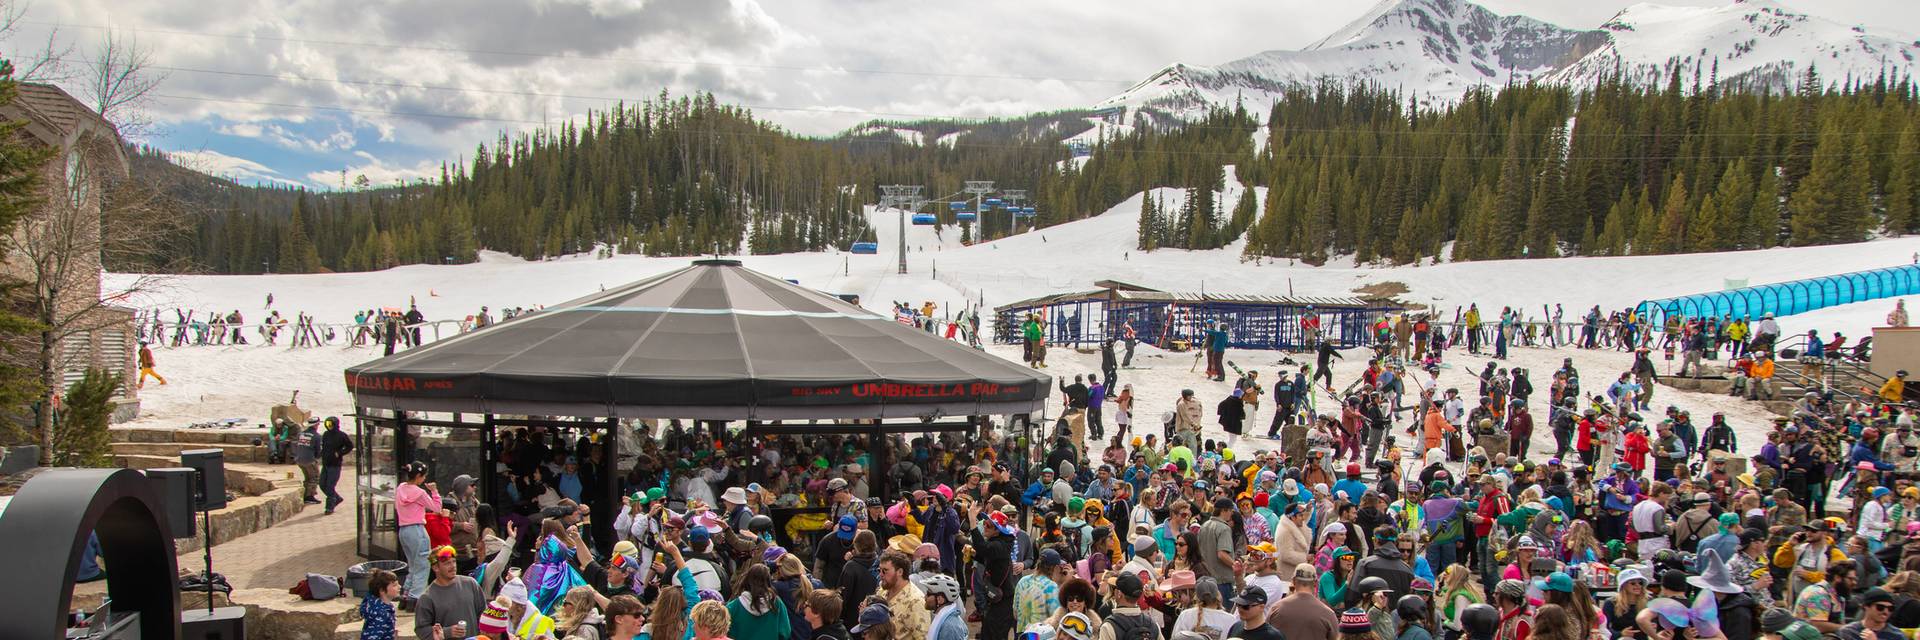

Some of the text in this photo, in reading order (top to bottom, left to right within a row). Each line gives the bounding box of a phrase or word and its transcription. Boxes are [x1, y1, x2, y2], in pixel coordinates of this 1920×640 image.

[384, 376, 417, 390] BAR
[792, 387, 813, 397] BIG
[816, 386, 841, 396] SKY
[852, 383, 965, 397] UMBRELLA
[970, 382, 999, 395] BAR
[1340, 615, 1370, 623] SNOW
